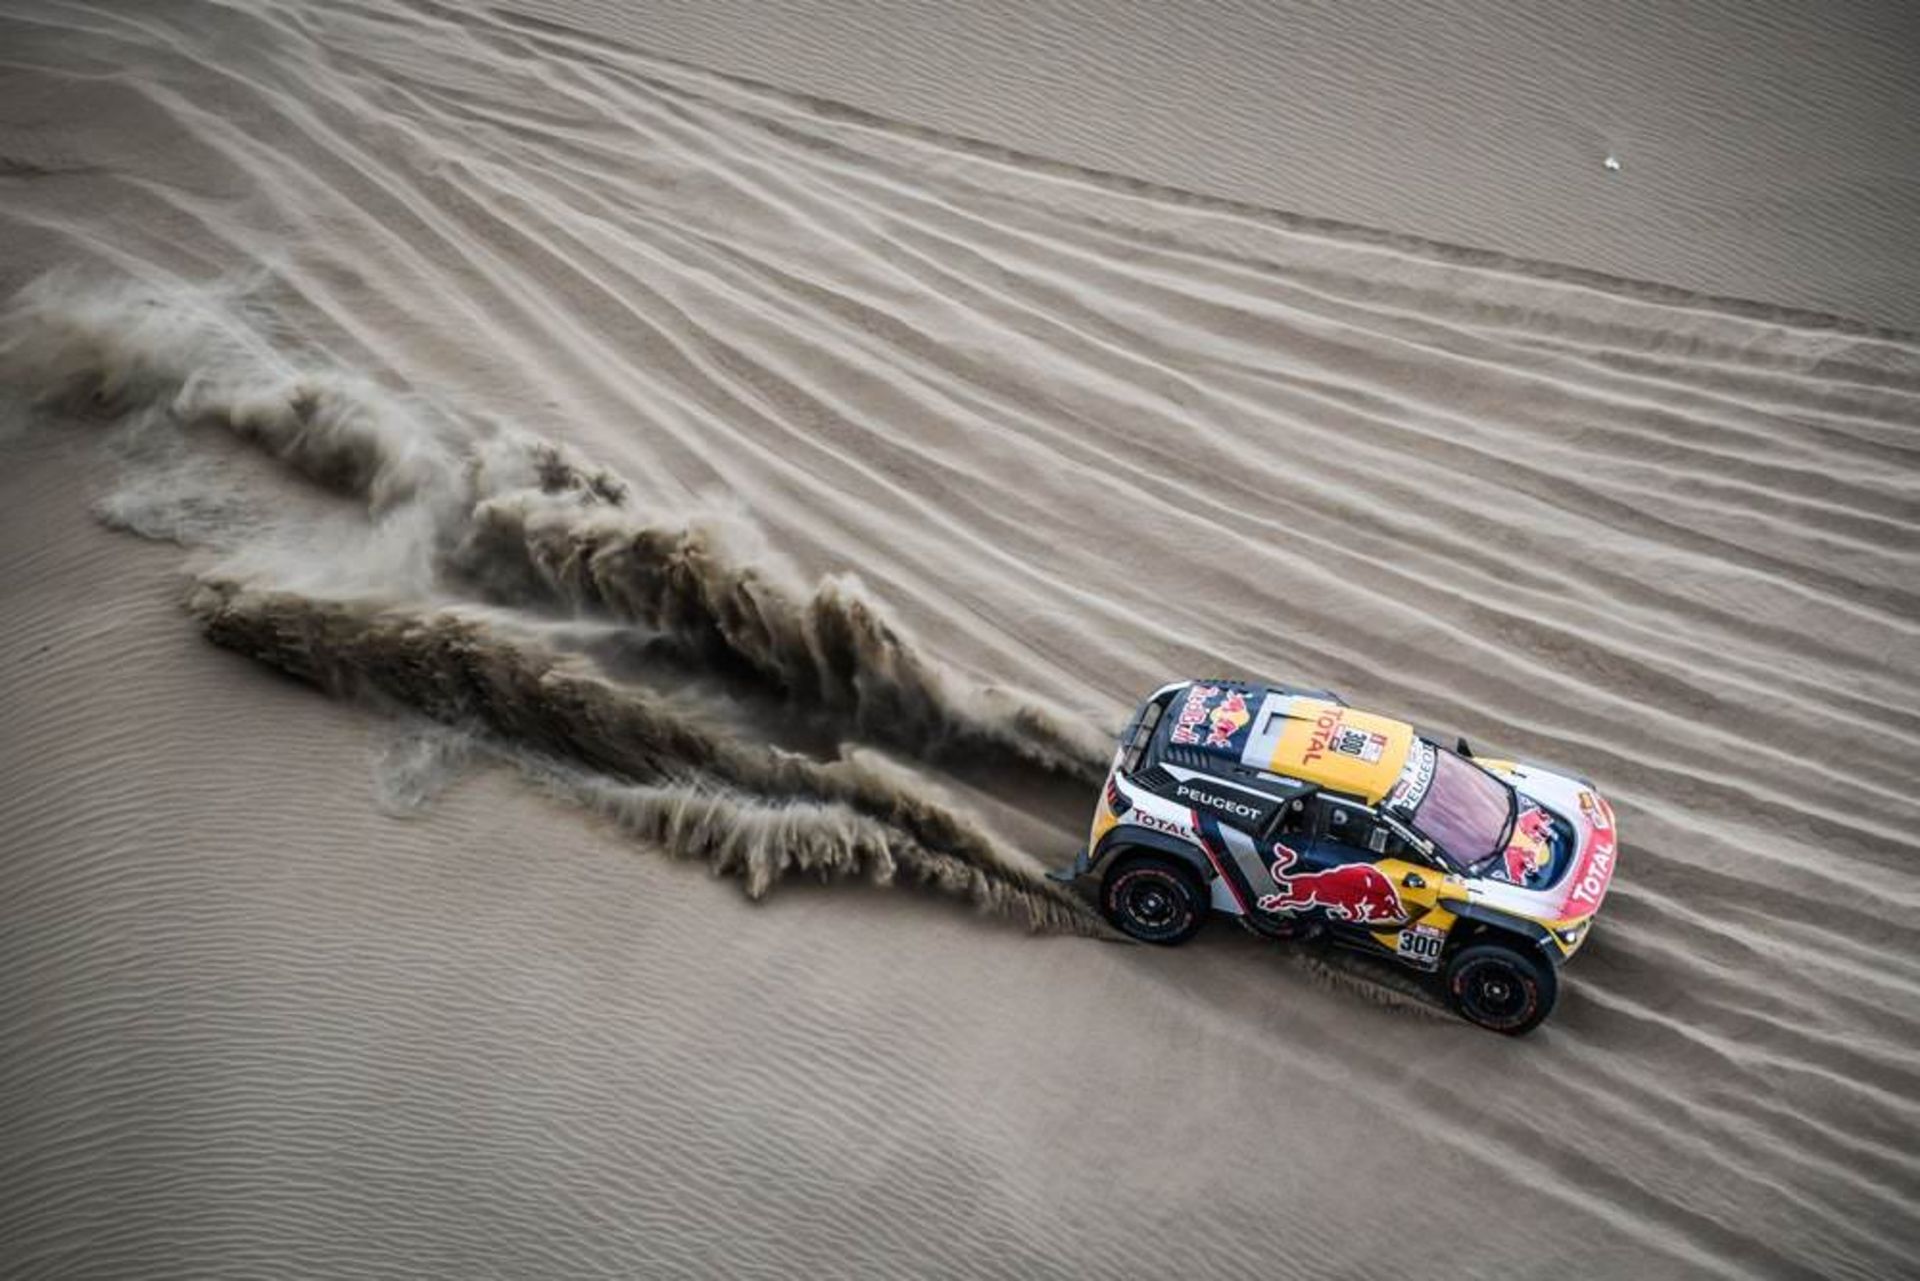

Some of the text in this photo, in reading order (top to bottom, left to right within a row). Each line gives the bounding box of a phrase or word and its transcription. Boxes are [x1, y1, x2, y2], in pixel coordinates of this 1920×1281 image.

[1302, 709, 1344, 766] TOTAL
[1339, 730, 1367, 756] 300
[1176, 785, 1262, 820] PEUGEOT
[1132, 807, 1190, 838] TOTAL
[1572, 843, 1613, 903] TOTAL
[1400, 931, 1441, 957] 300
